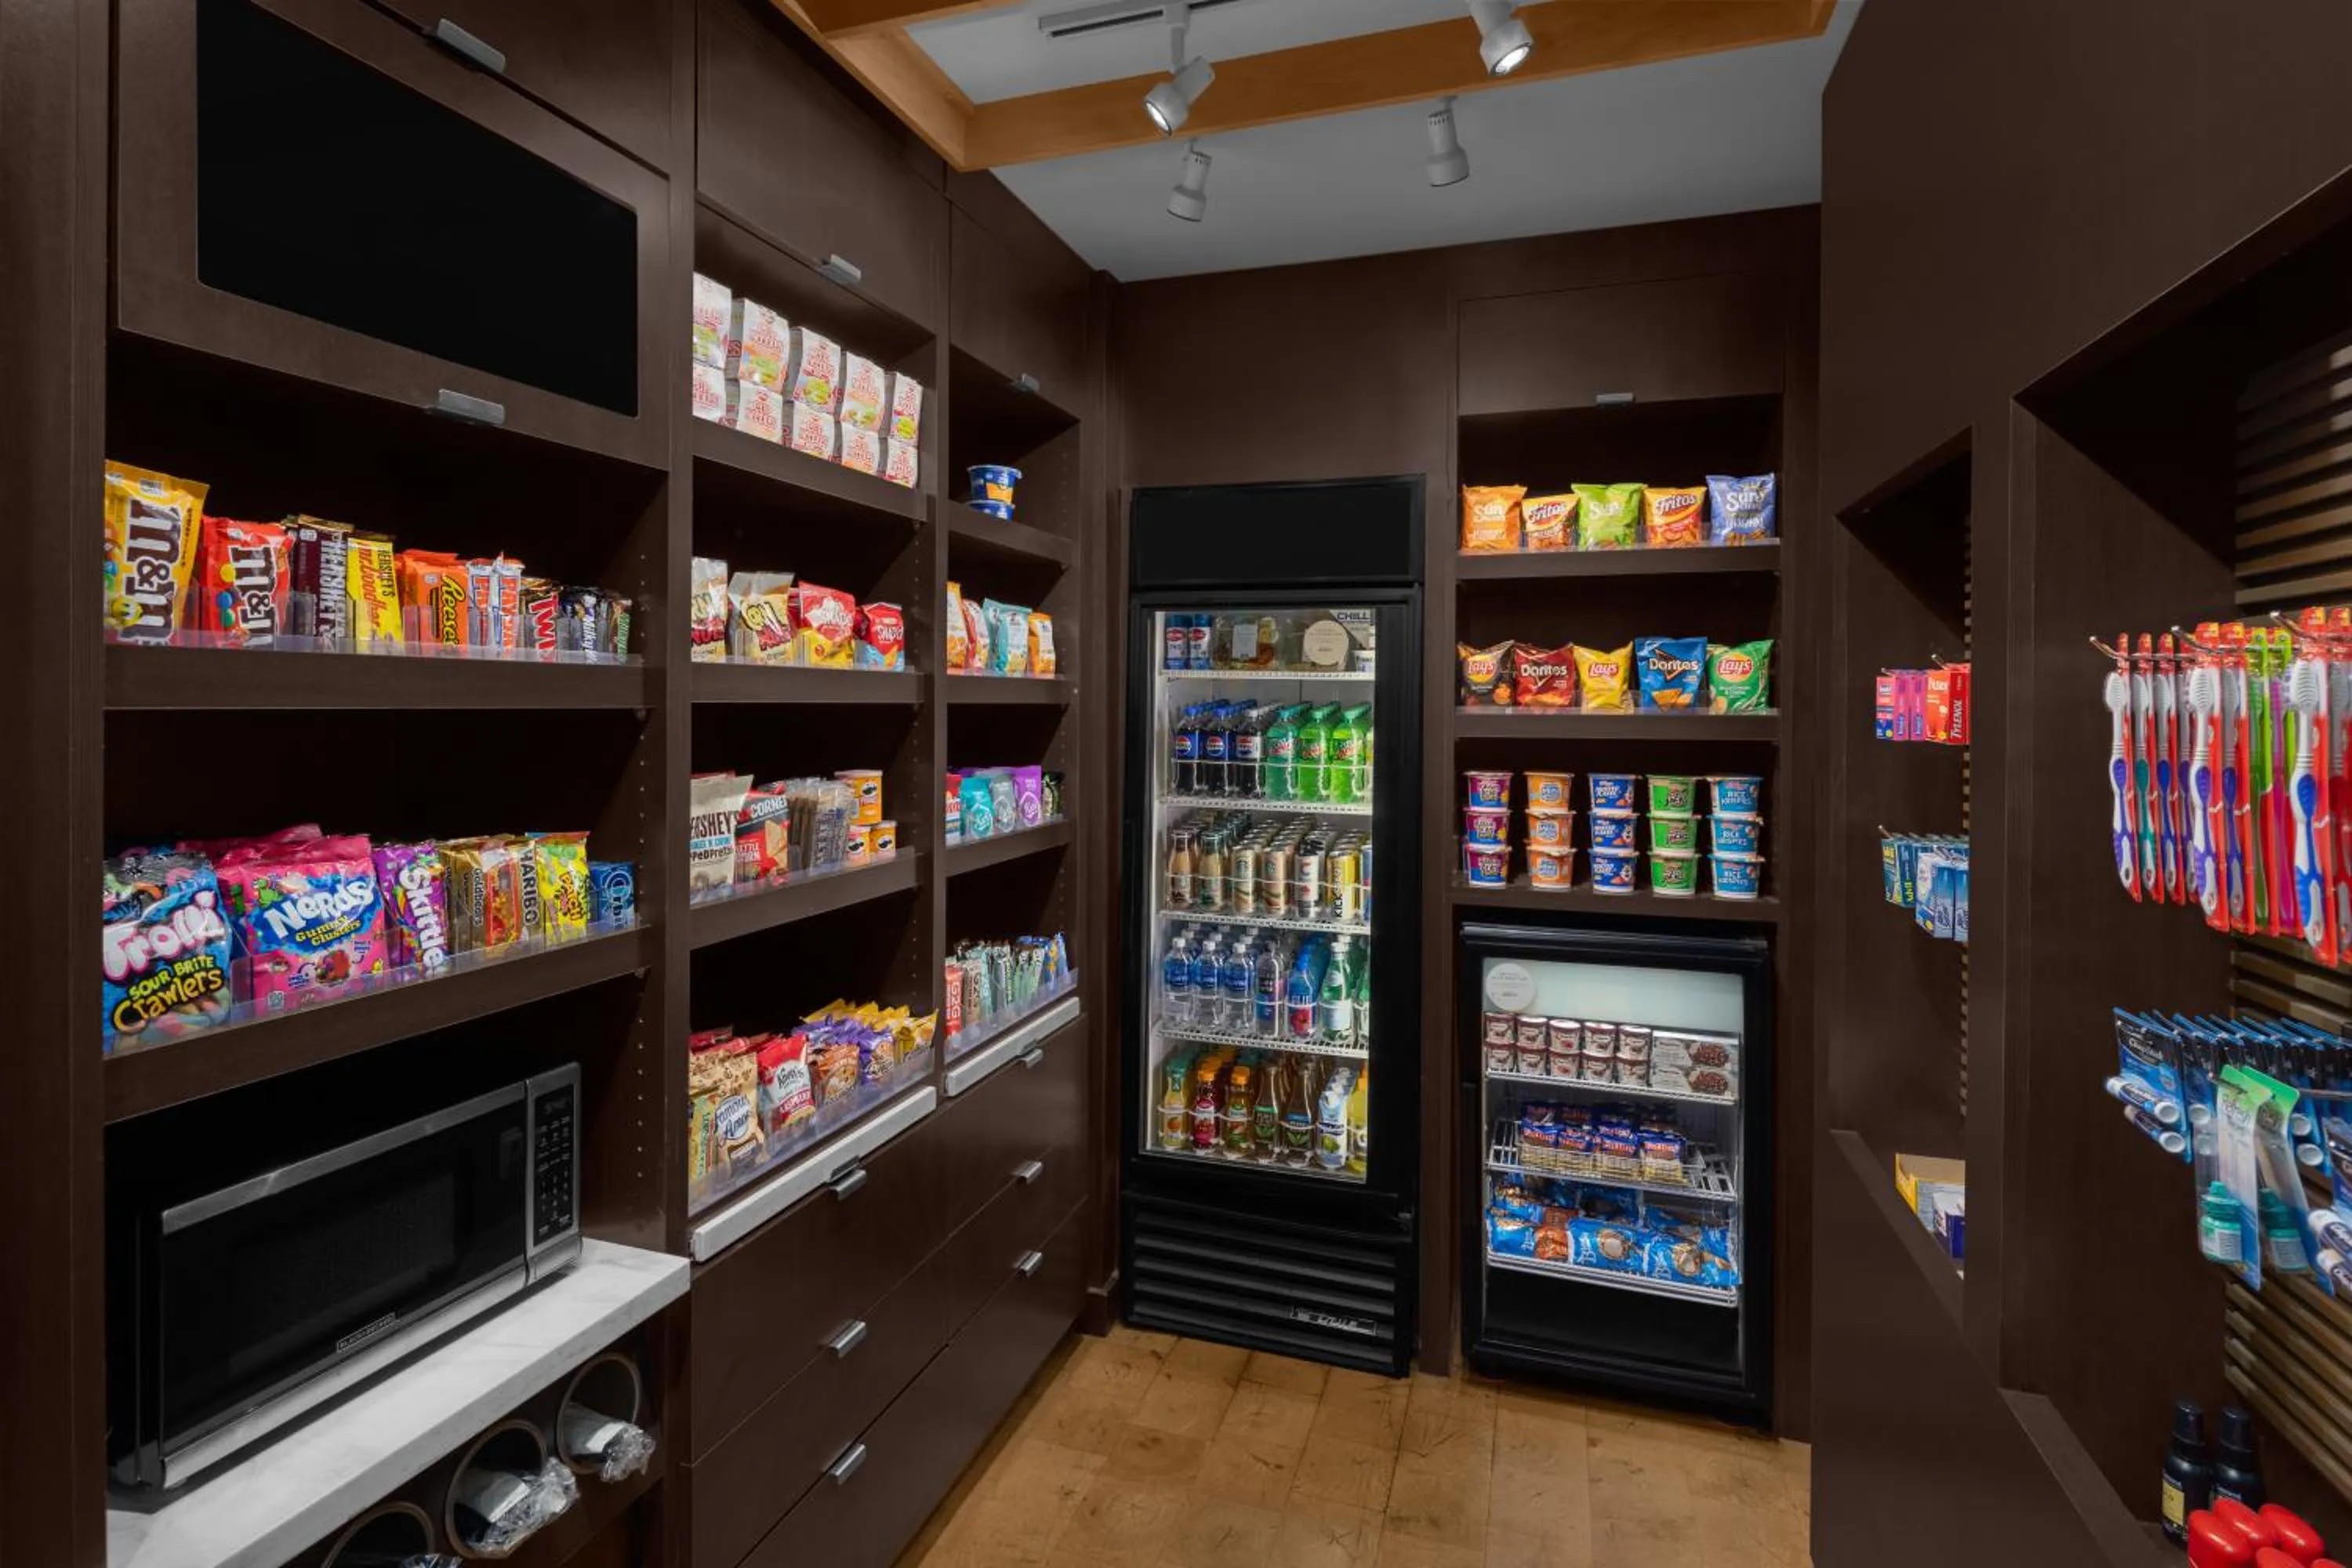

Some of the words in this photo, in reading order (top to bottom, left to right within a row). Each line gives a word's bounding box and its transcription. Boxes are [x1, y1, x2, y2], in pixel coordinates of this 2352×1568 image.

[1528, 500, 1566, 524] Fritos
[1656, 493, 1697, 513] Fritos
[1520, 663, 1567, 677] Doritos
[1649, 658, 1699, 671] Doritos
[520, 848, 539, 925] HARIBO
[103, 890, 228, 981] Trolli
[295, 914, 349, 942] Gummy
[311, 918, 362, 946] Clusters
[128, 968, 172, 1001] SOUR
[172, 956, 216, 978] BRITE
[113, 968, 223, 1033] Crawlers
